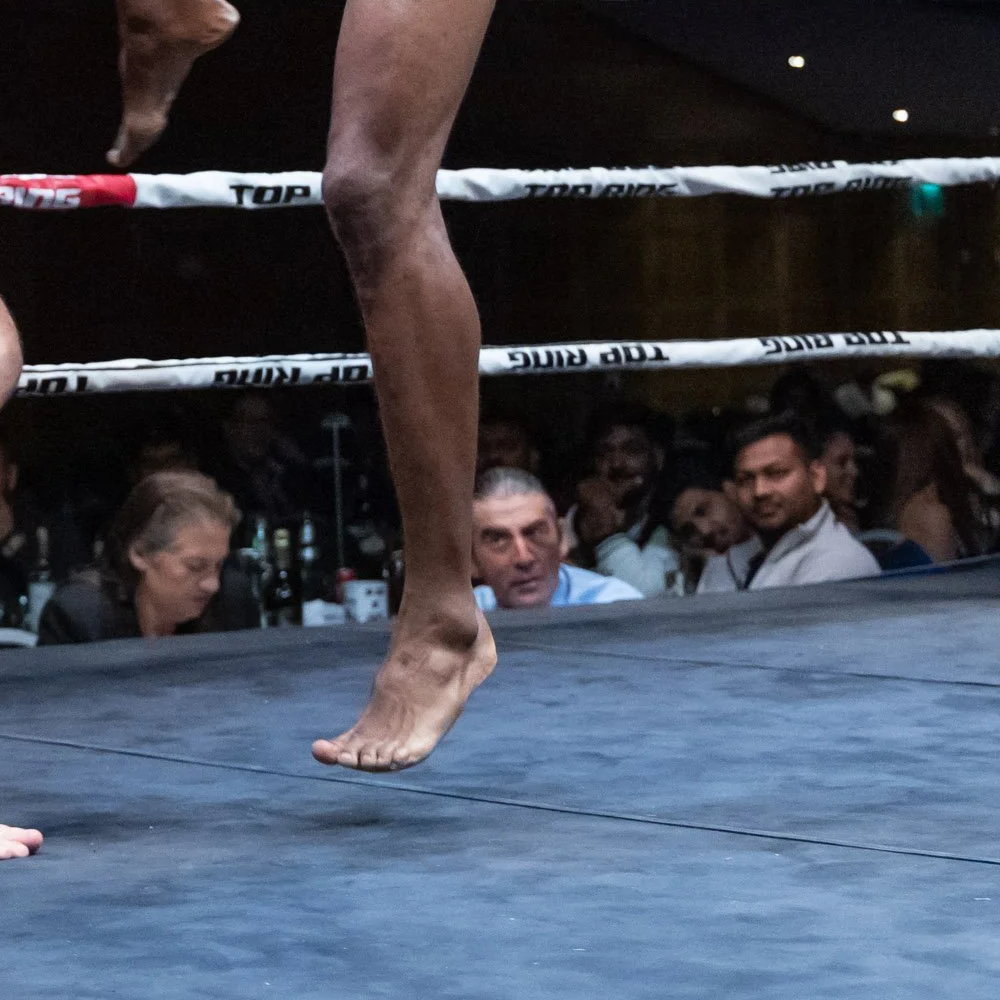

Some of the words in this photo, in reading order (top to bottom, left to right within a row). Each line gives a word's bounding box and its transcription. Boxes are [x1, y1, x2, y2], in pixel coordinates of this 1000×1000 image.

[229, 184, 311, 205] TOP
[507, 347, 588, 370] RING
[600, 343, 670, 364] TOP
